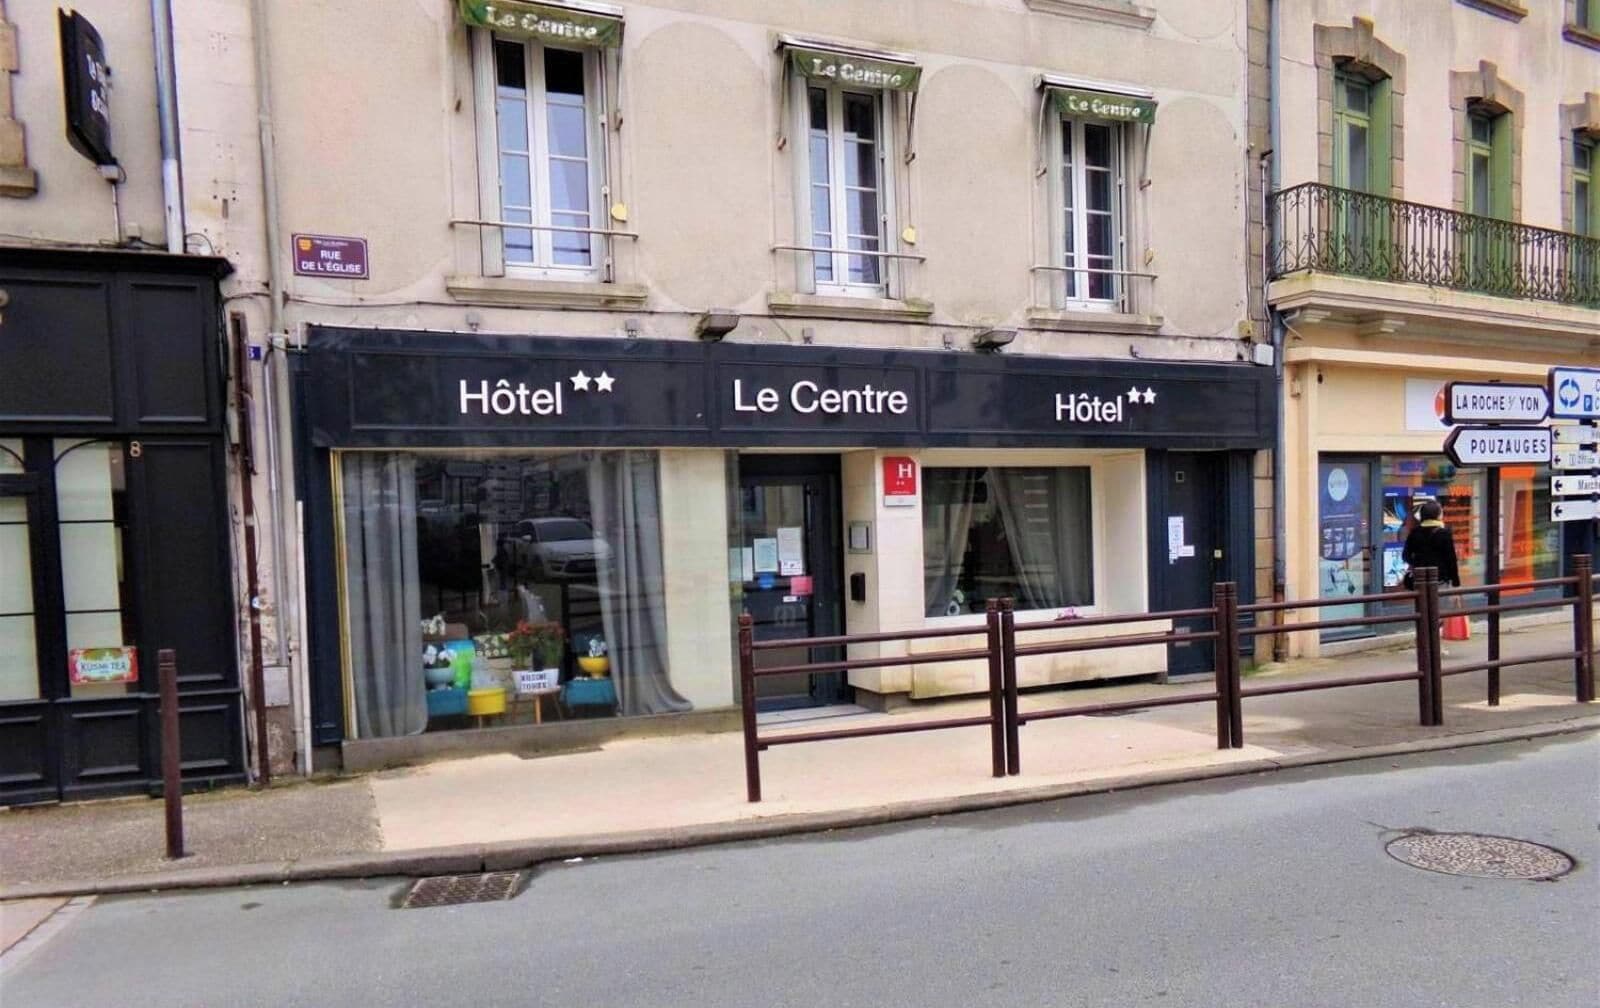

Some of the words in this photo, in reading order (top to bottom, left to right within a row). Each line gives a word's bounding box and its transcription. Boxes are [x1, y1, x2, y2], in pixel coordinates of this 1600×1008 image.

[486, 6, 515, 27] Le
[521, 13, 598, 39] Centre
[812, 58, 837, 77] Le
[840, 63, 901, 86] Centre
[1091, 98, 1141, 118] Centre
[320, 249, 342, 260] RUE
[301, 260, 316, 271] DE
[318, 261, 362, 274] L'ÉGLISE
[459, 378, 563, 415] Hôtel
[734, 378, 779, 413] Le
[790, 380, 908, 414] Centre
[1456, 395, 1468, 410] LA
[1472, 395, 1505, 411] ROCHE
[1519, 397, 1540, 412] YON
[1055, 392, 1123, 422] Hôtel
[130, 441, 141, 457] 8
[1470, 438, 1547, 454] POUZAUGES
[898, 463, 912, 478] H
